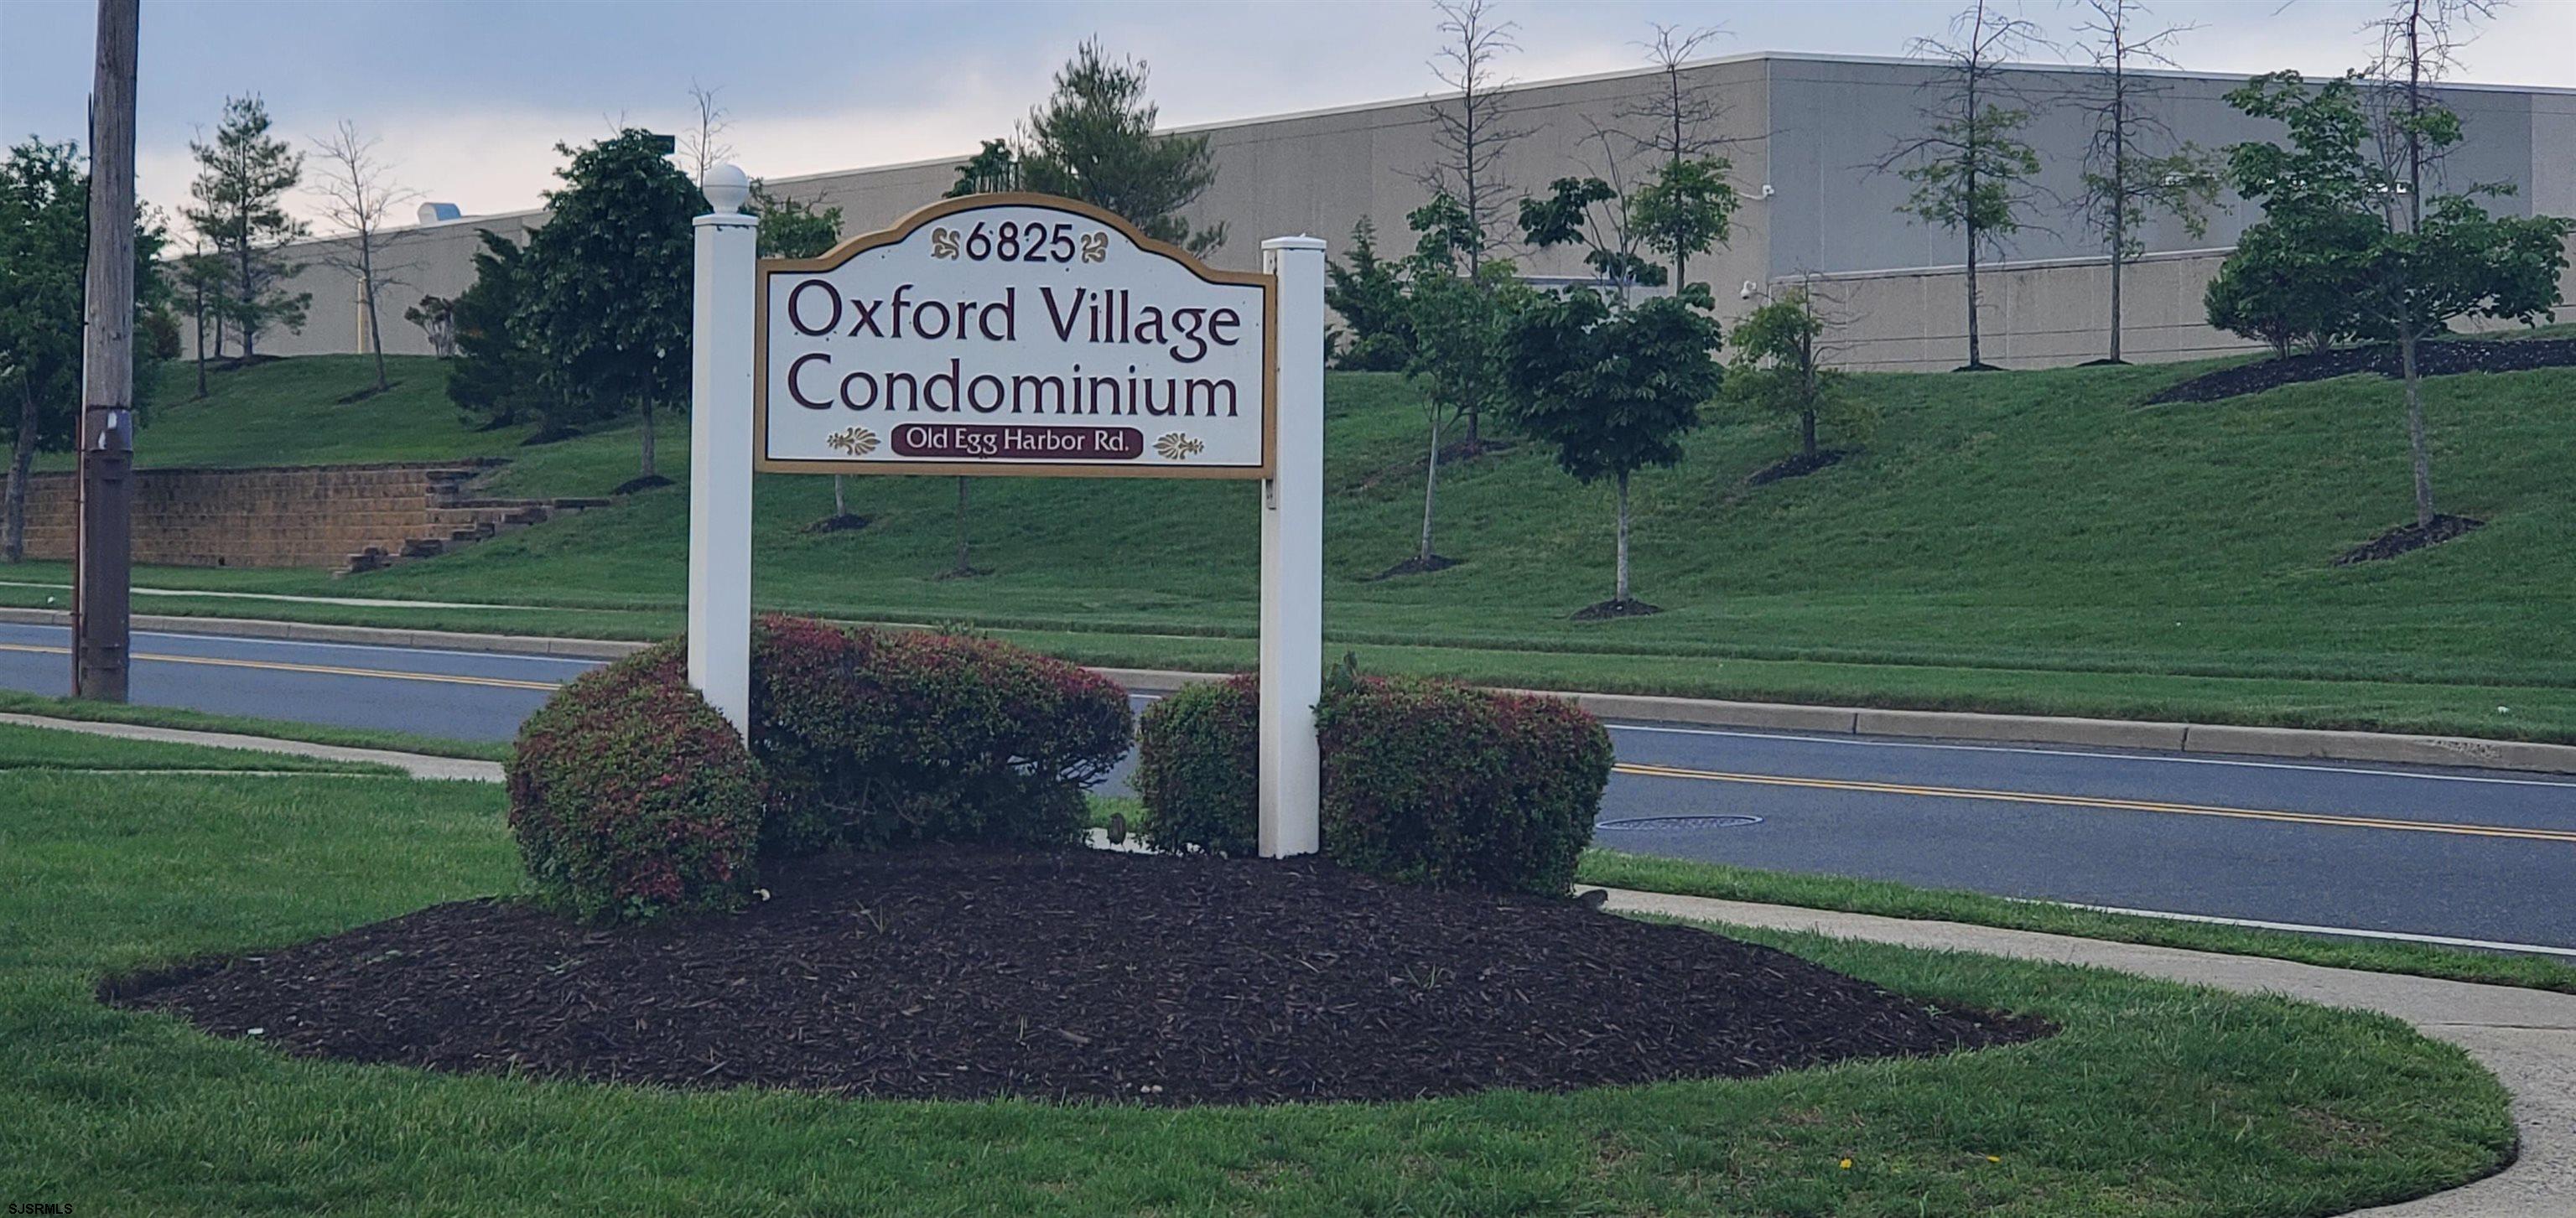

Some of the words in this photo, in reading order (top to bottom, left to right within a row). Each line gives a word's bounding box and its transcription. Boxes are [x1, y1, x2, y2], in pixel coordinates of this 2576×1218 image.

[965, 221, 1075, 262] 6825
[787, 279, 1015, 341] Oxford
[1040, 286, 1241, 363] Village
[787, 353, 1239, 417] Condominium
[906, 427, 948, 449] Old
[954, 428, 998, 454] Egg
[1004, 429, 1085, 452] Harbor
[1094, 430, 1129, 453] Rd.
